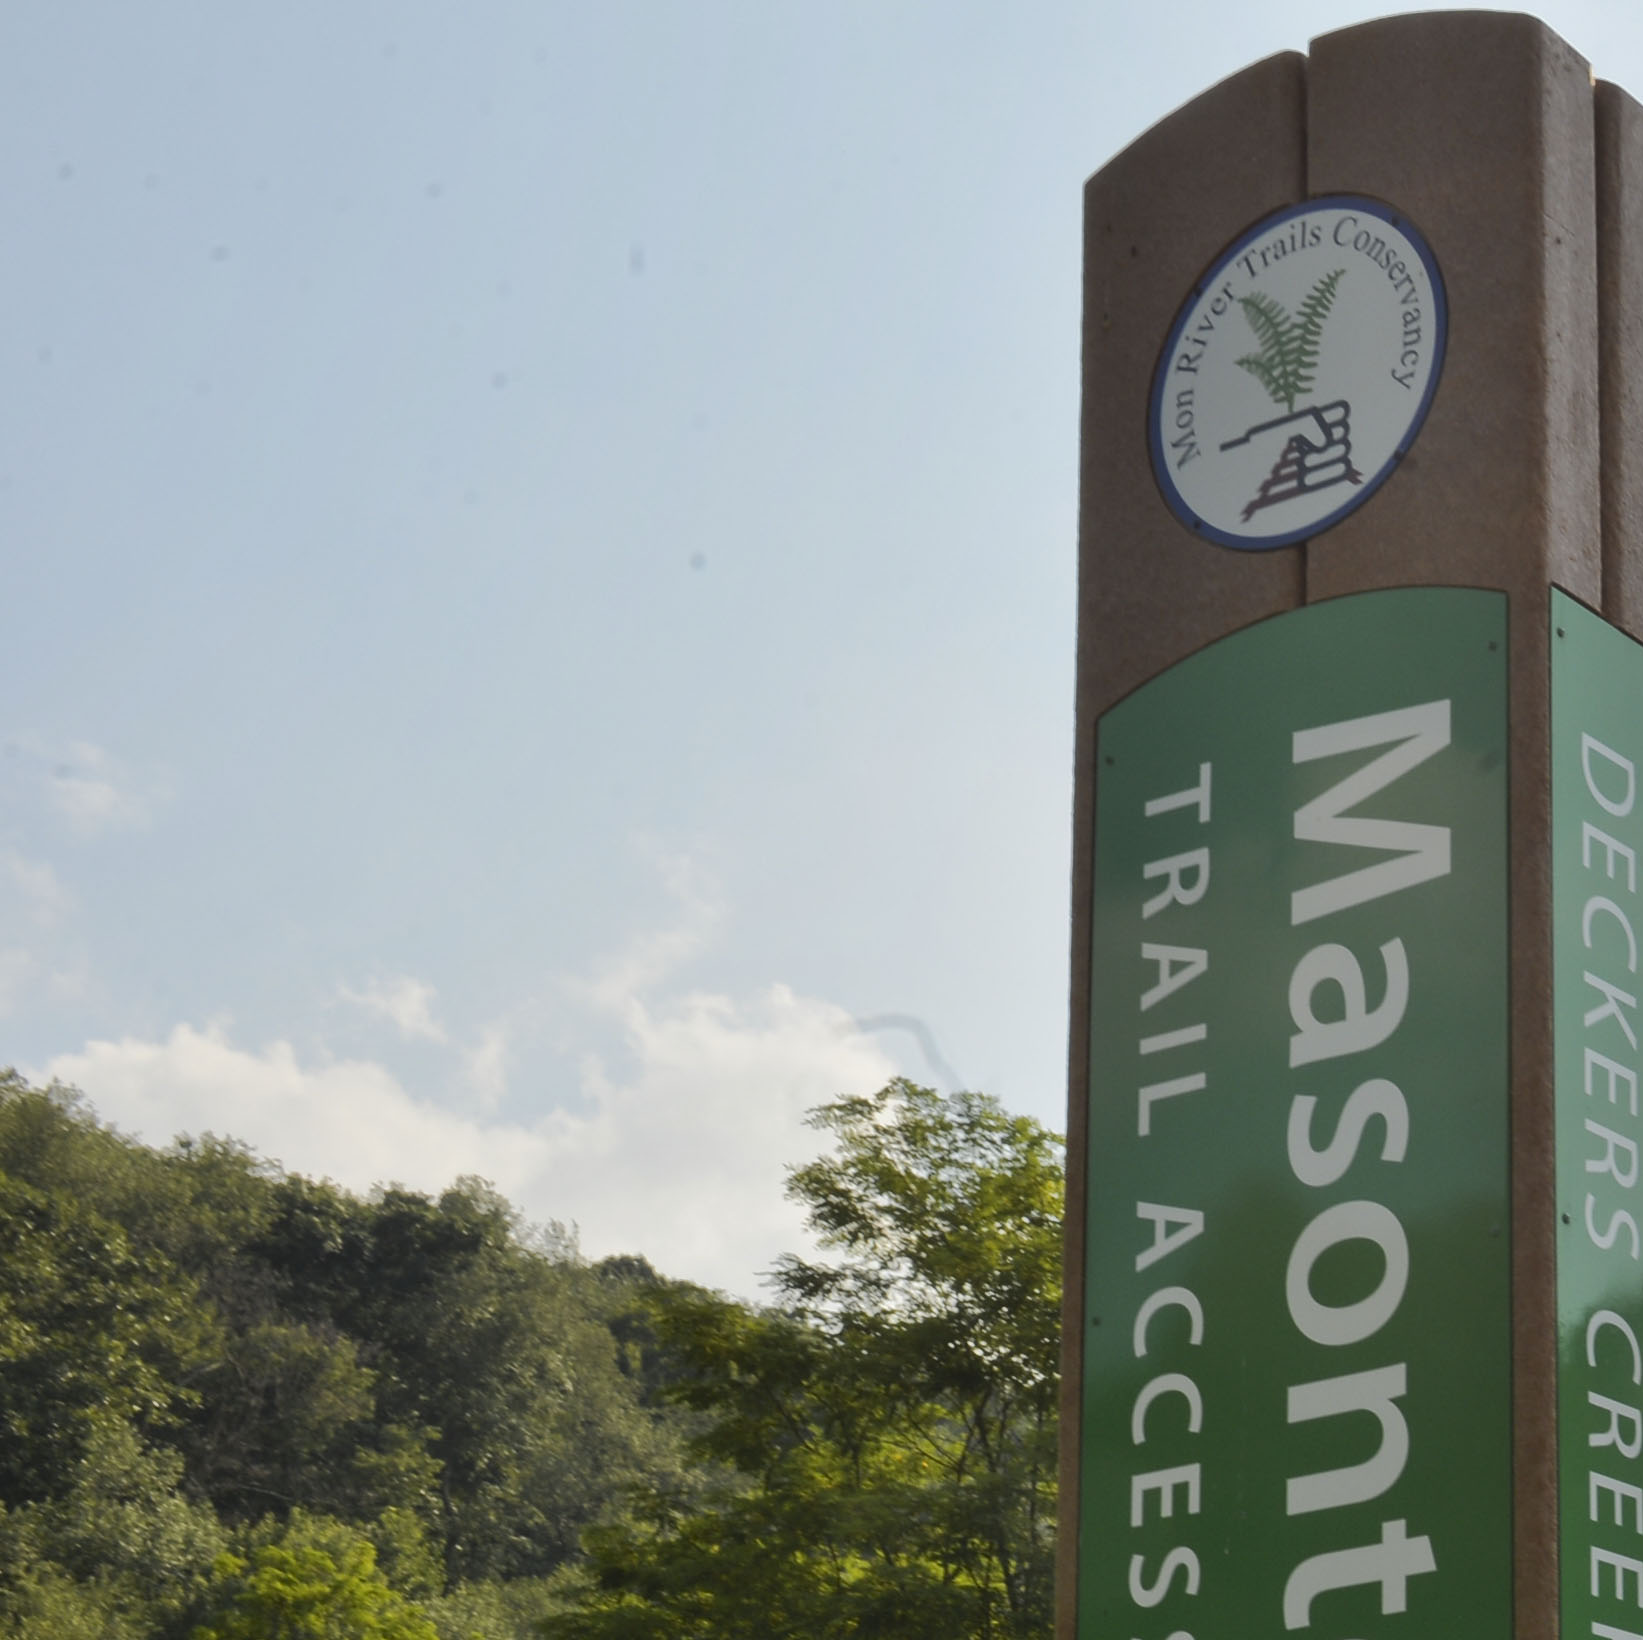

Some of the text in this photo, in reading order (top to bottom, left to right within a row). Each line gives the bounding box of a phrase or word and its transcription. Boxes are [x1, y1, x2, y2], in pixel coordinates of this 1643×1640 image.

[1170, 215, 1424, 471] Mon River Trails Conservancy
[1137, 761, 1212, 1137] TRAIL
[1581, 731, 1640, 1261] DECKERS
